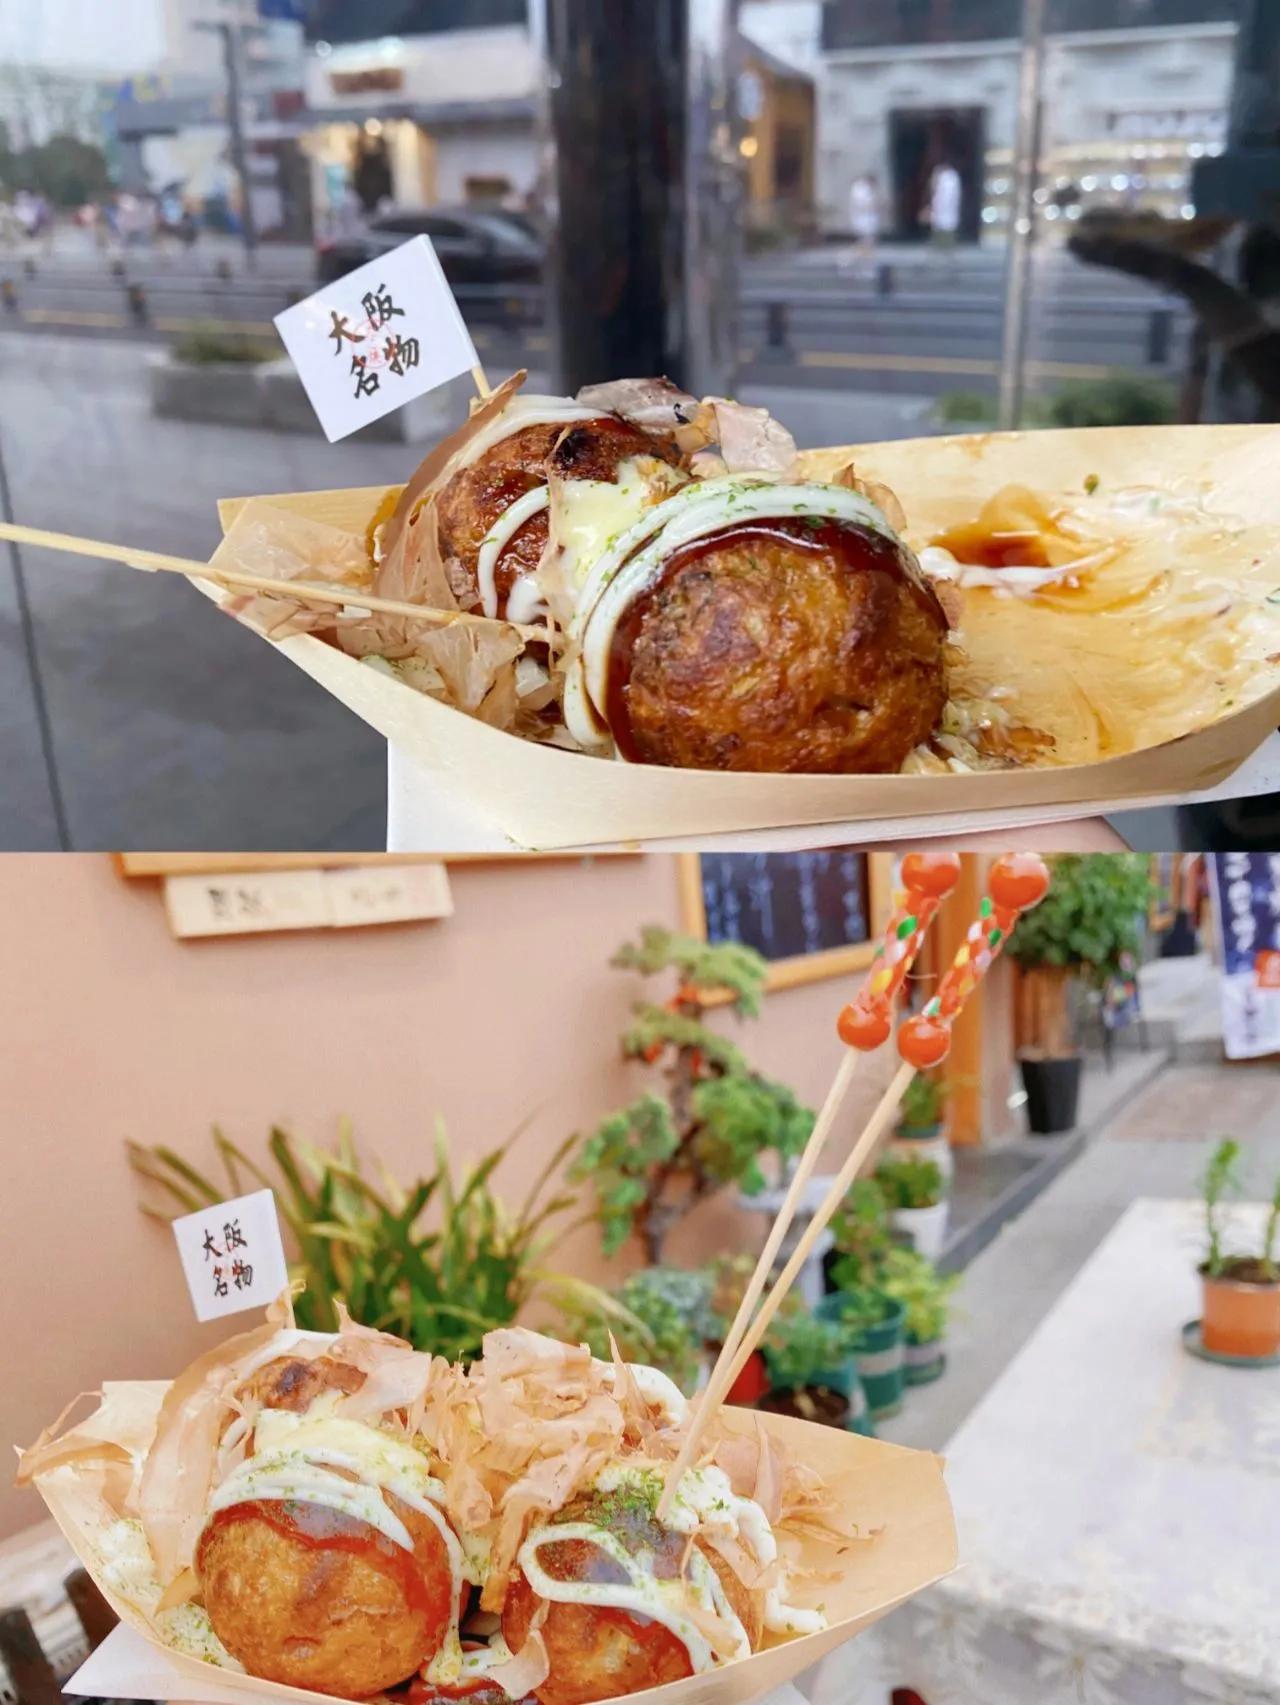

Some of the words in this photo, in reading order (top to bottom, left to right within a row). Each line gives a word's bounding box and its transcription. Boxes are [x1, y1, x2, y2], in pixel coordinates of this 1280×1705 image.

[328, 283, 406, 356] 大阪
[349, 334, 420, 399] 名物
[202, 1218, 248, 1261] 大阪
[213, 1259, 253, 1297] 名物
